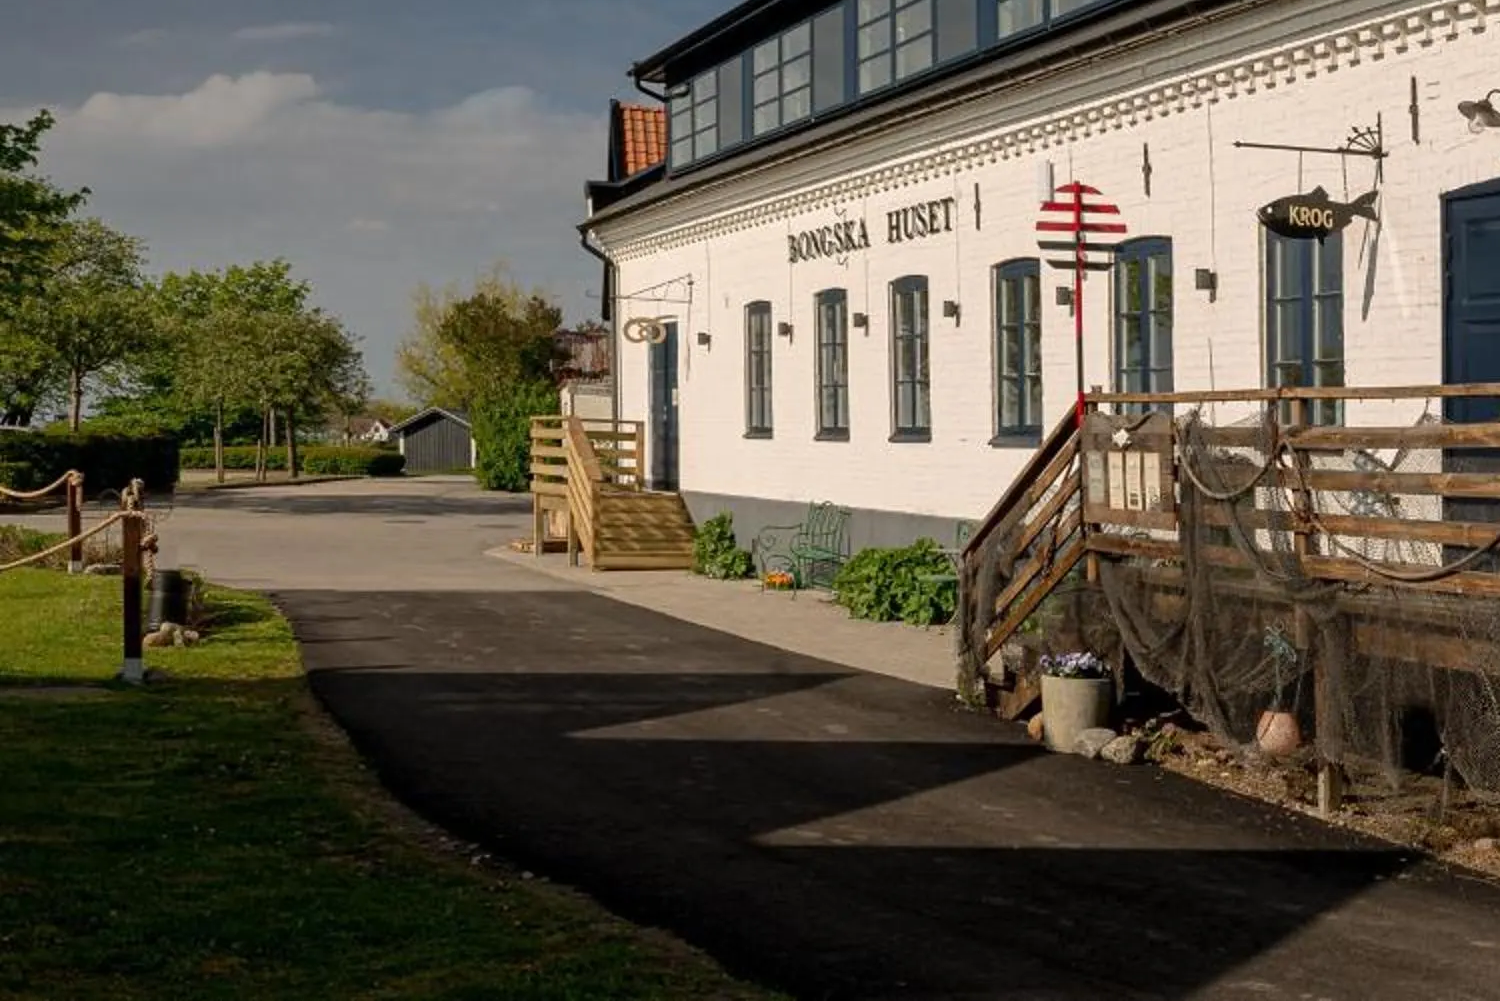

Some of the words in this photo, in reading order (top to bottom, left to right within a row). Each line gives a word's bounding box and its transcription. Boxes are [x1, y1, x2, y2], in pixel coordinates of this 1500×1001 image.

[788, 218, 871, 263] BONGSKA
[887, 197, 955, 243] HUSET
[1289, 205, 1333, 227] KROG
